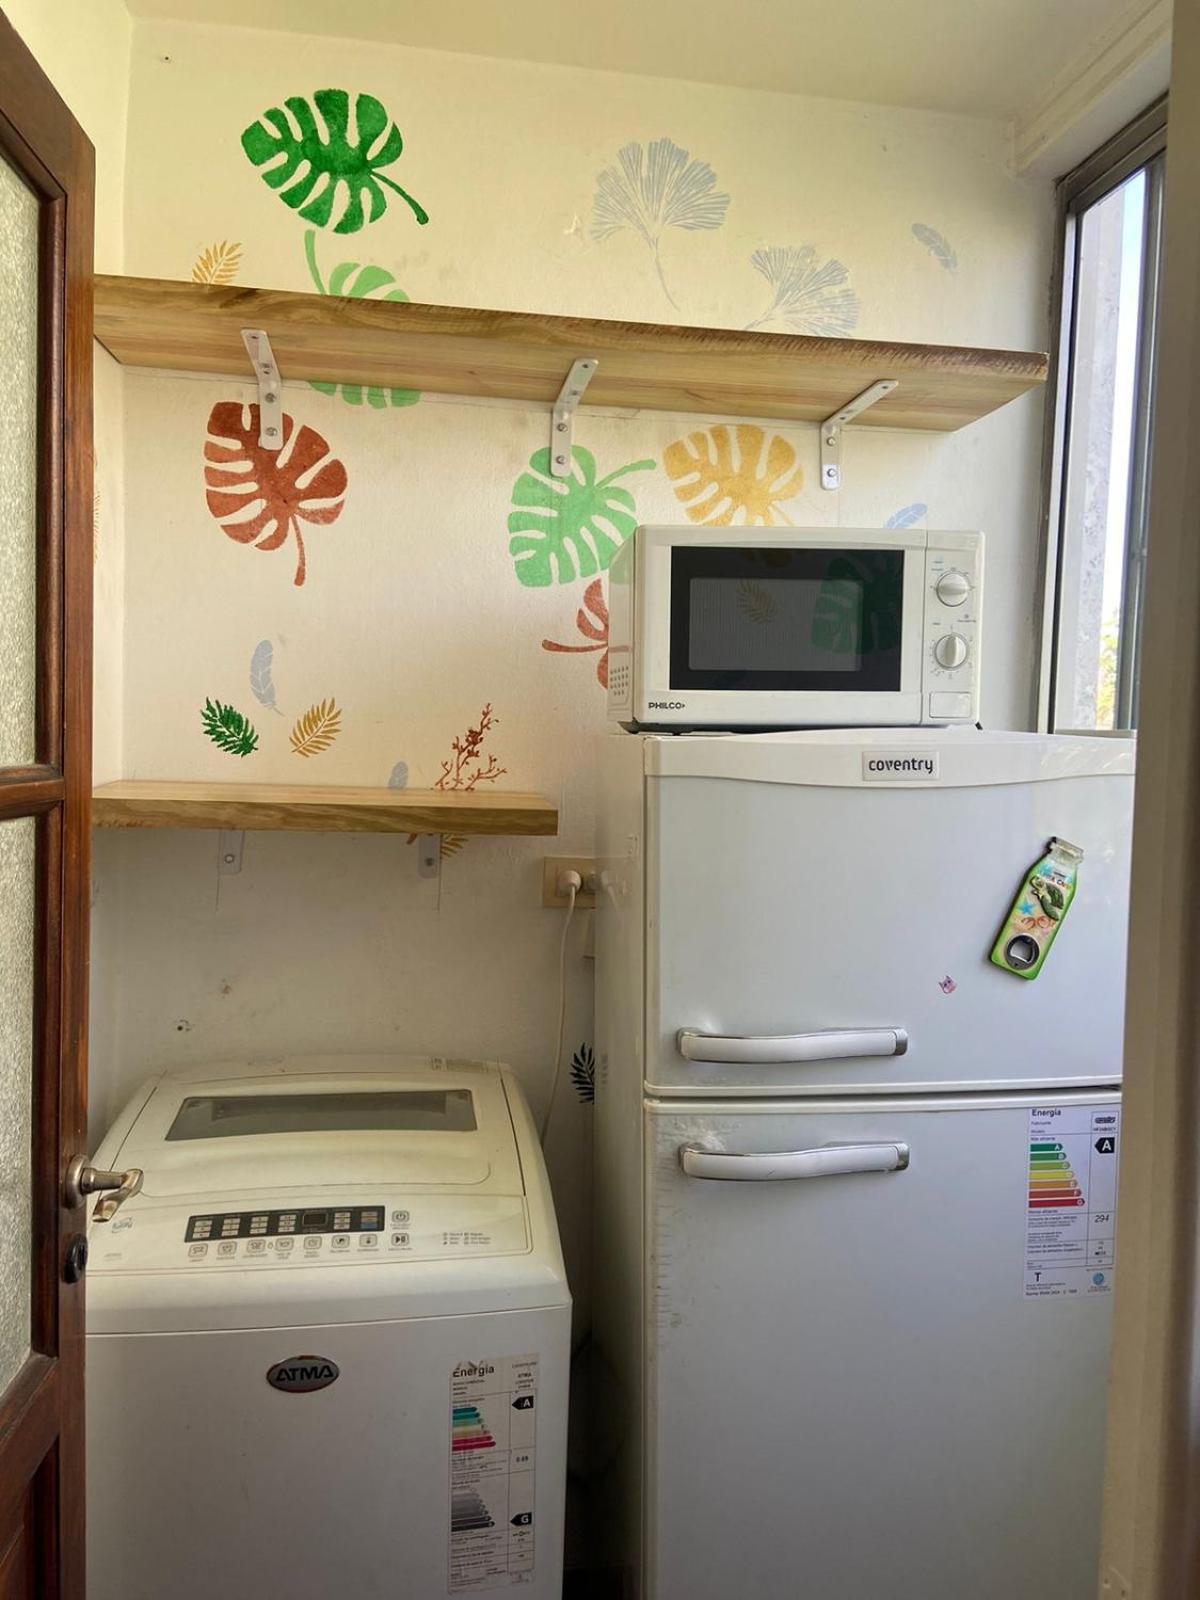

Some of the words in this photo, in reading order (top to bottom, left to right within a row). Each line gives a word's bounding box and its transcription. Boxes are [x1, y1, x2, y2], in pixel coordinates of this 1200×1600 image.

[869, 758, 933, 775] coventry
[1102, 1139, 1112, 1151] A
[1034, 1272, 1042, 1282] T
[276, 1365, 334, 1381] ATMA
[523, 1399, 531, 1408] A
[520, 1514, 529, 1524] G
